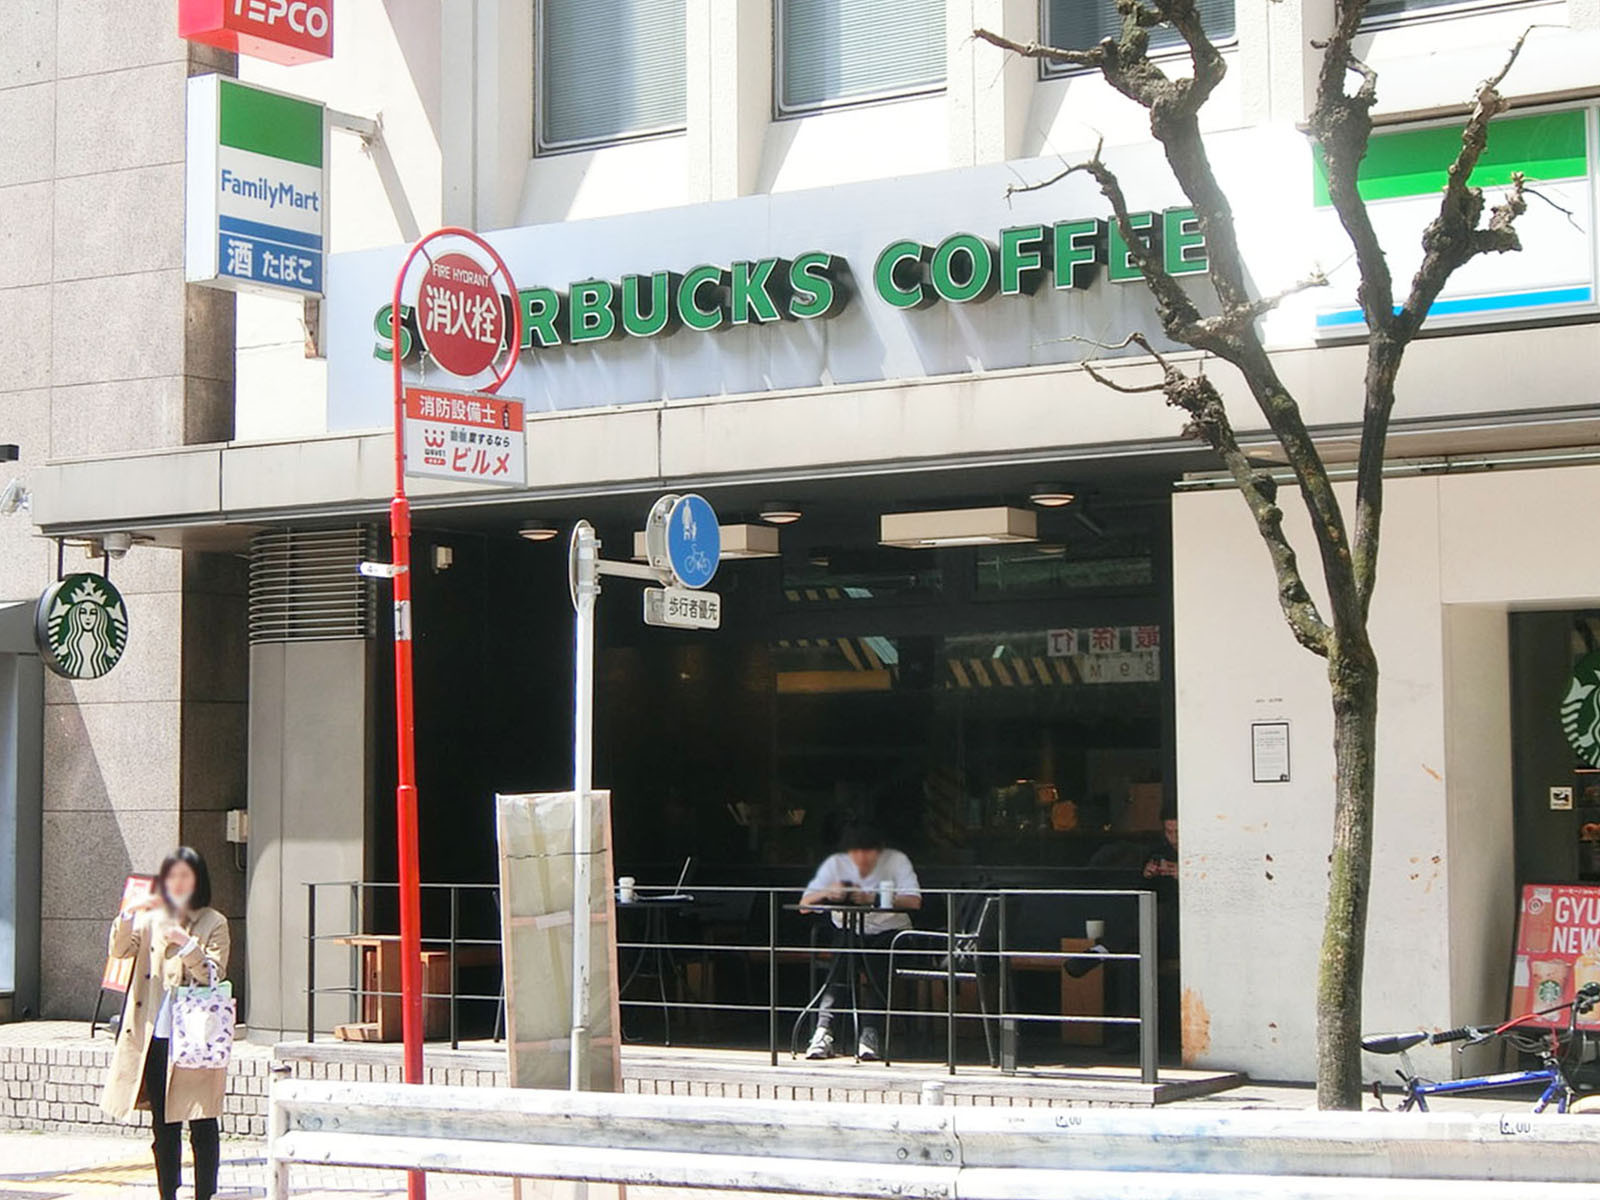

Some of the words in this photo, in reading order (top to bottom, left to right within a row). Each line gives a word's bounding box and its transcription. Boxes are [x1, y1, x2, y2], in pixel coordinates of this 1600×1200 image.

[221, 169, 319, 212] FamilyMart
[227, 238, 254, 278] 酒
[262, 250, 314, 285] たばこ
[432, 263, 451, 280] FIRE
[452, 267, 490, 288] HYDRANT
[372, 251, 836, 362] SRBUCKS
[873, 205, 1210, 310] COFFEE
[425, 284, 498, 344] 消火栓
[419, 395, 497, 425] 消防設備士
[452, 447, 511, 476] ビルメ
[669, 597, 718, 621] 歩行者優先
[1551, 926, 1600, 954] NEW
